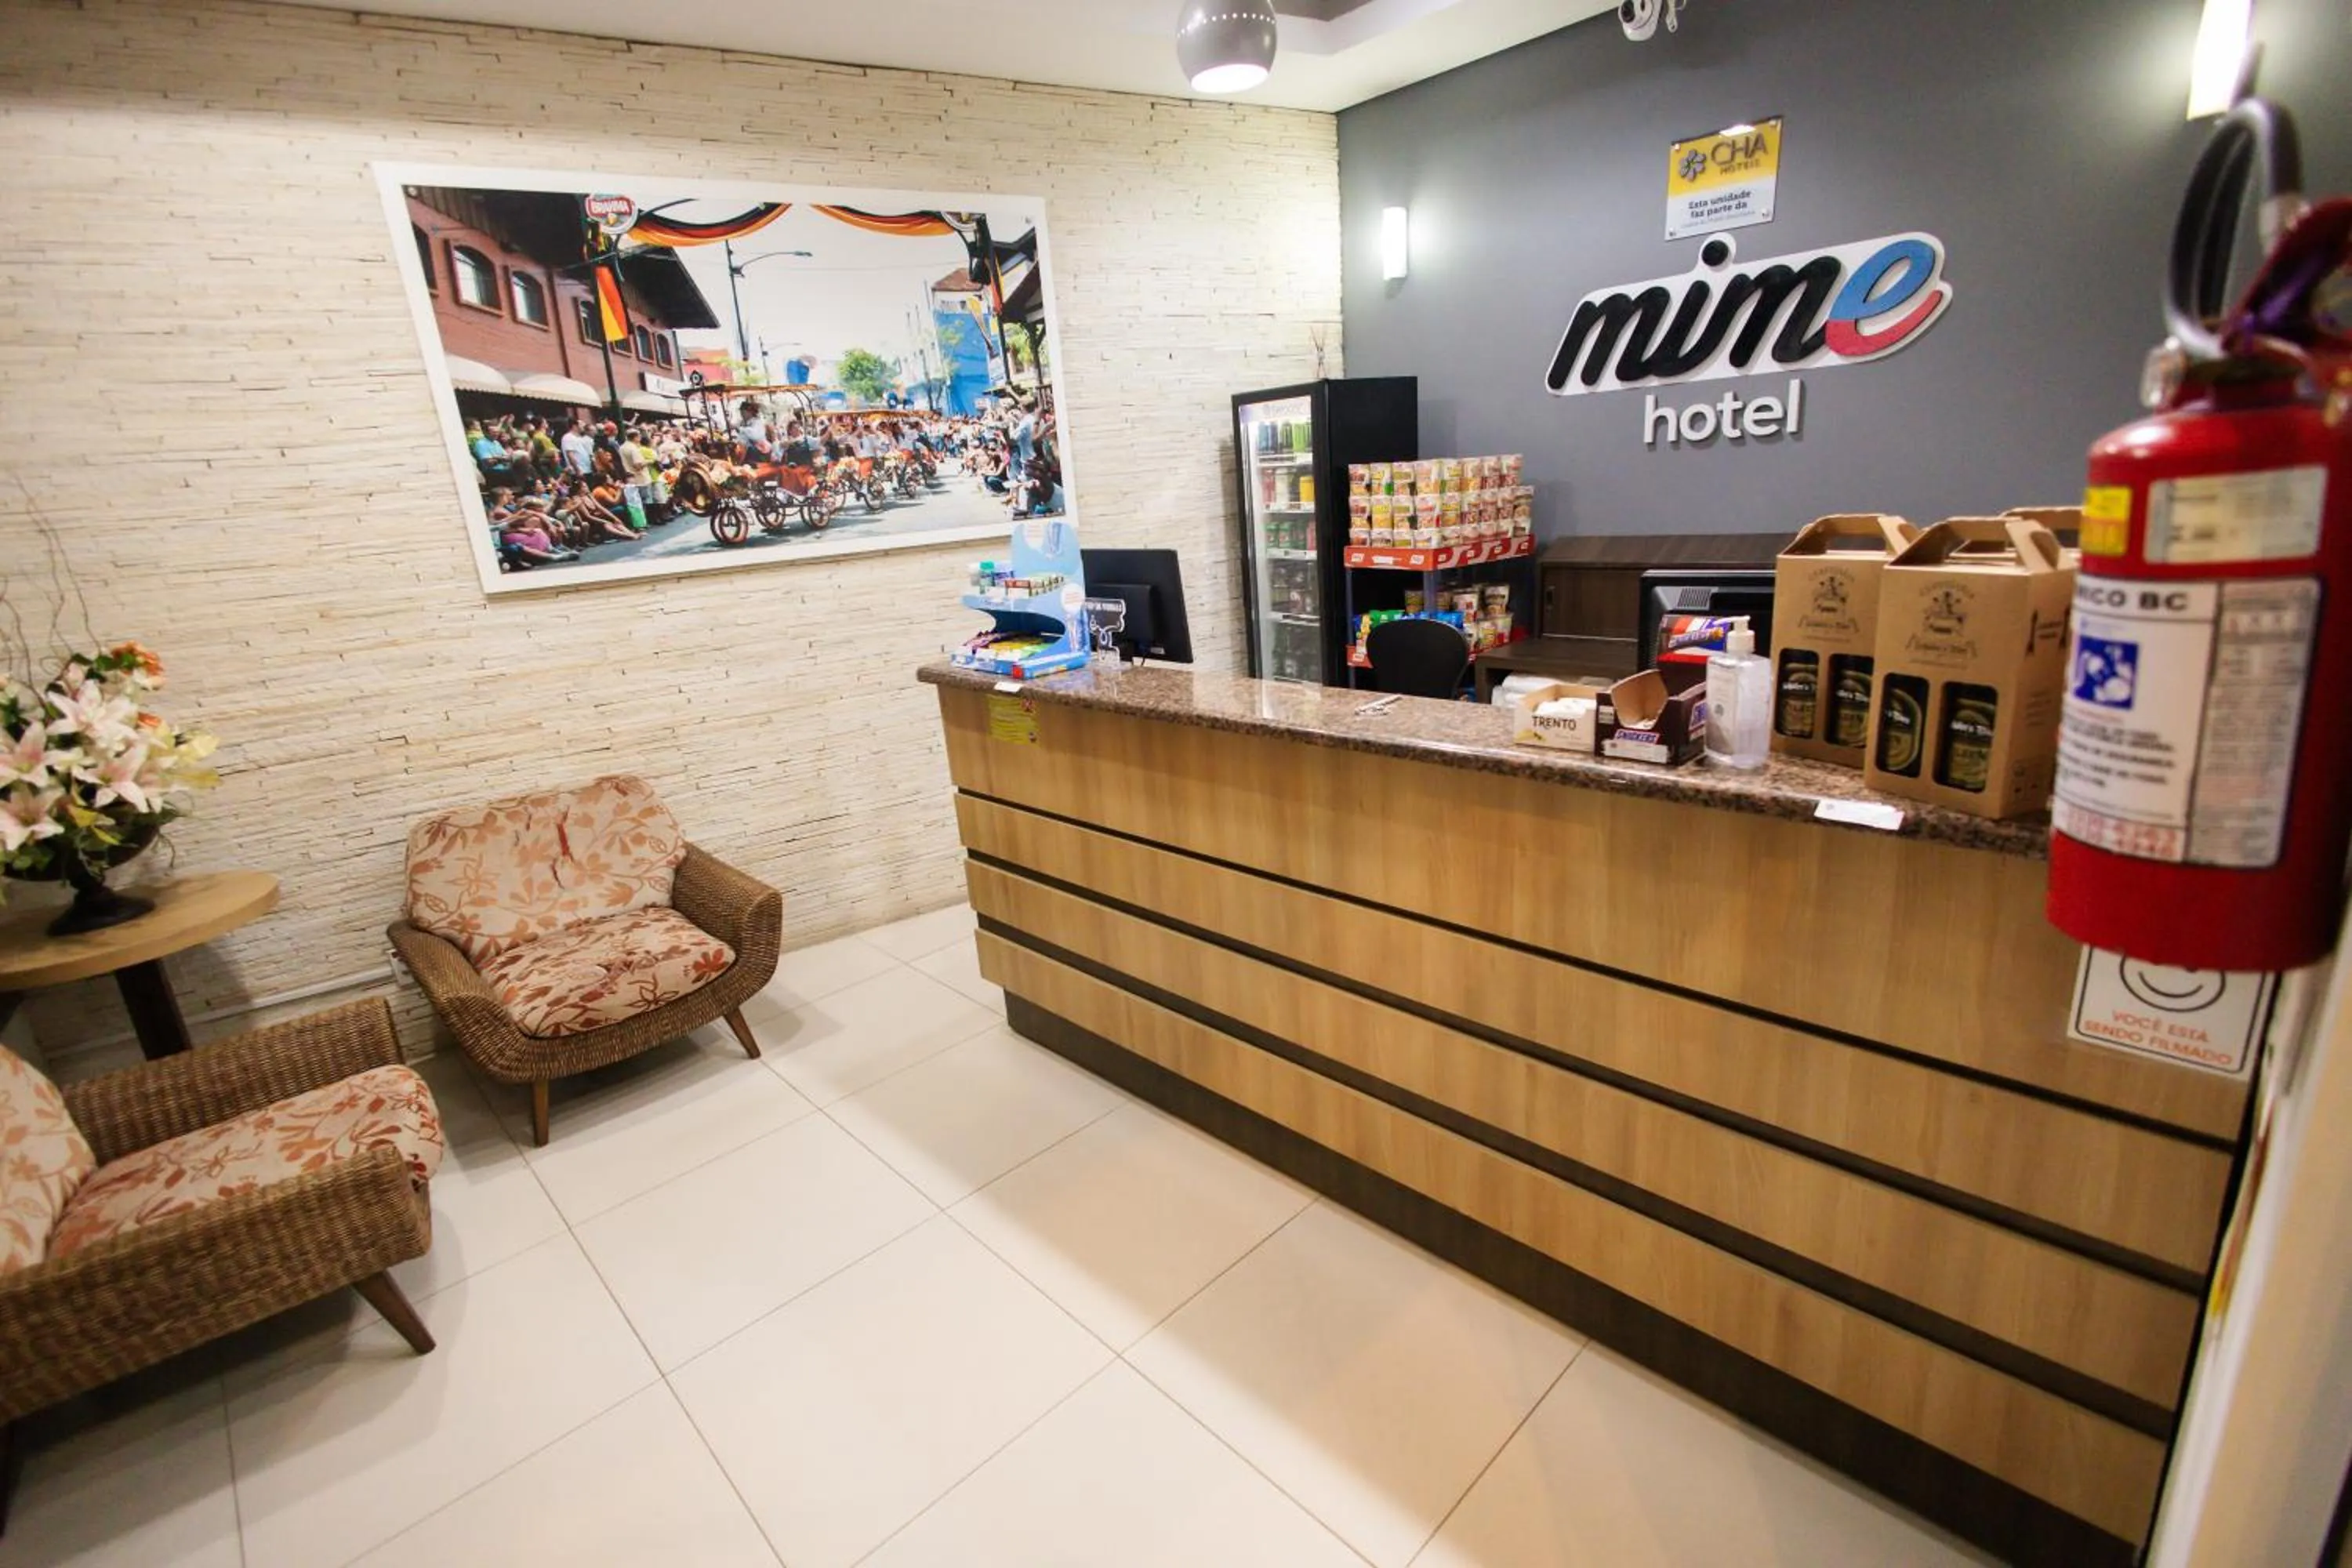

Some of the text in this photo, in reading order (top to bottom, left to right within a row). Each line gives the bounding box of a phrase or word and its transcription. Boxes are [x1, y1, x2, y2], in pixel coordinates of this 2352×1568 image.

[1711, 133, 1769, 165] CHA
[1688, 190, 1751, 209] Esta unidade
[1707, 205, 1733, 217] parte
[1734, 201, 1748, 210] da
[1548, 238, 1944, 390] mime
[1642, 379, 1802, 445] hotel
[2140, 590, 2188, 611] BC
[1531, 714, 1577, 731] TRENTO
[1616, 730, 1658, 744] SNICKERS
[2112, 1008, 2209, 1044] VOCÊ ESTÁ
[2082, 1019, 2234, 1065] SENDO FILMADO
